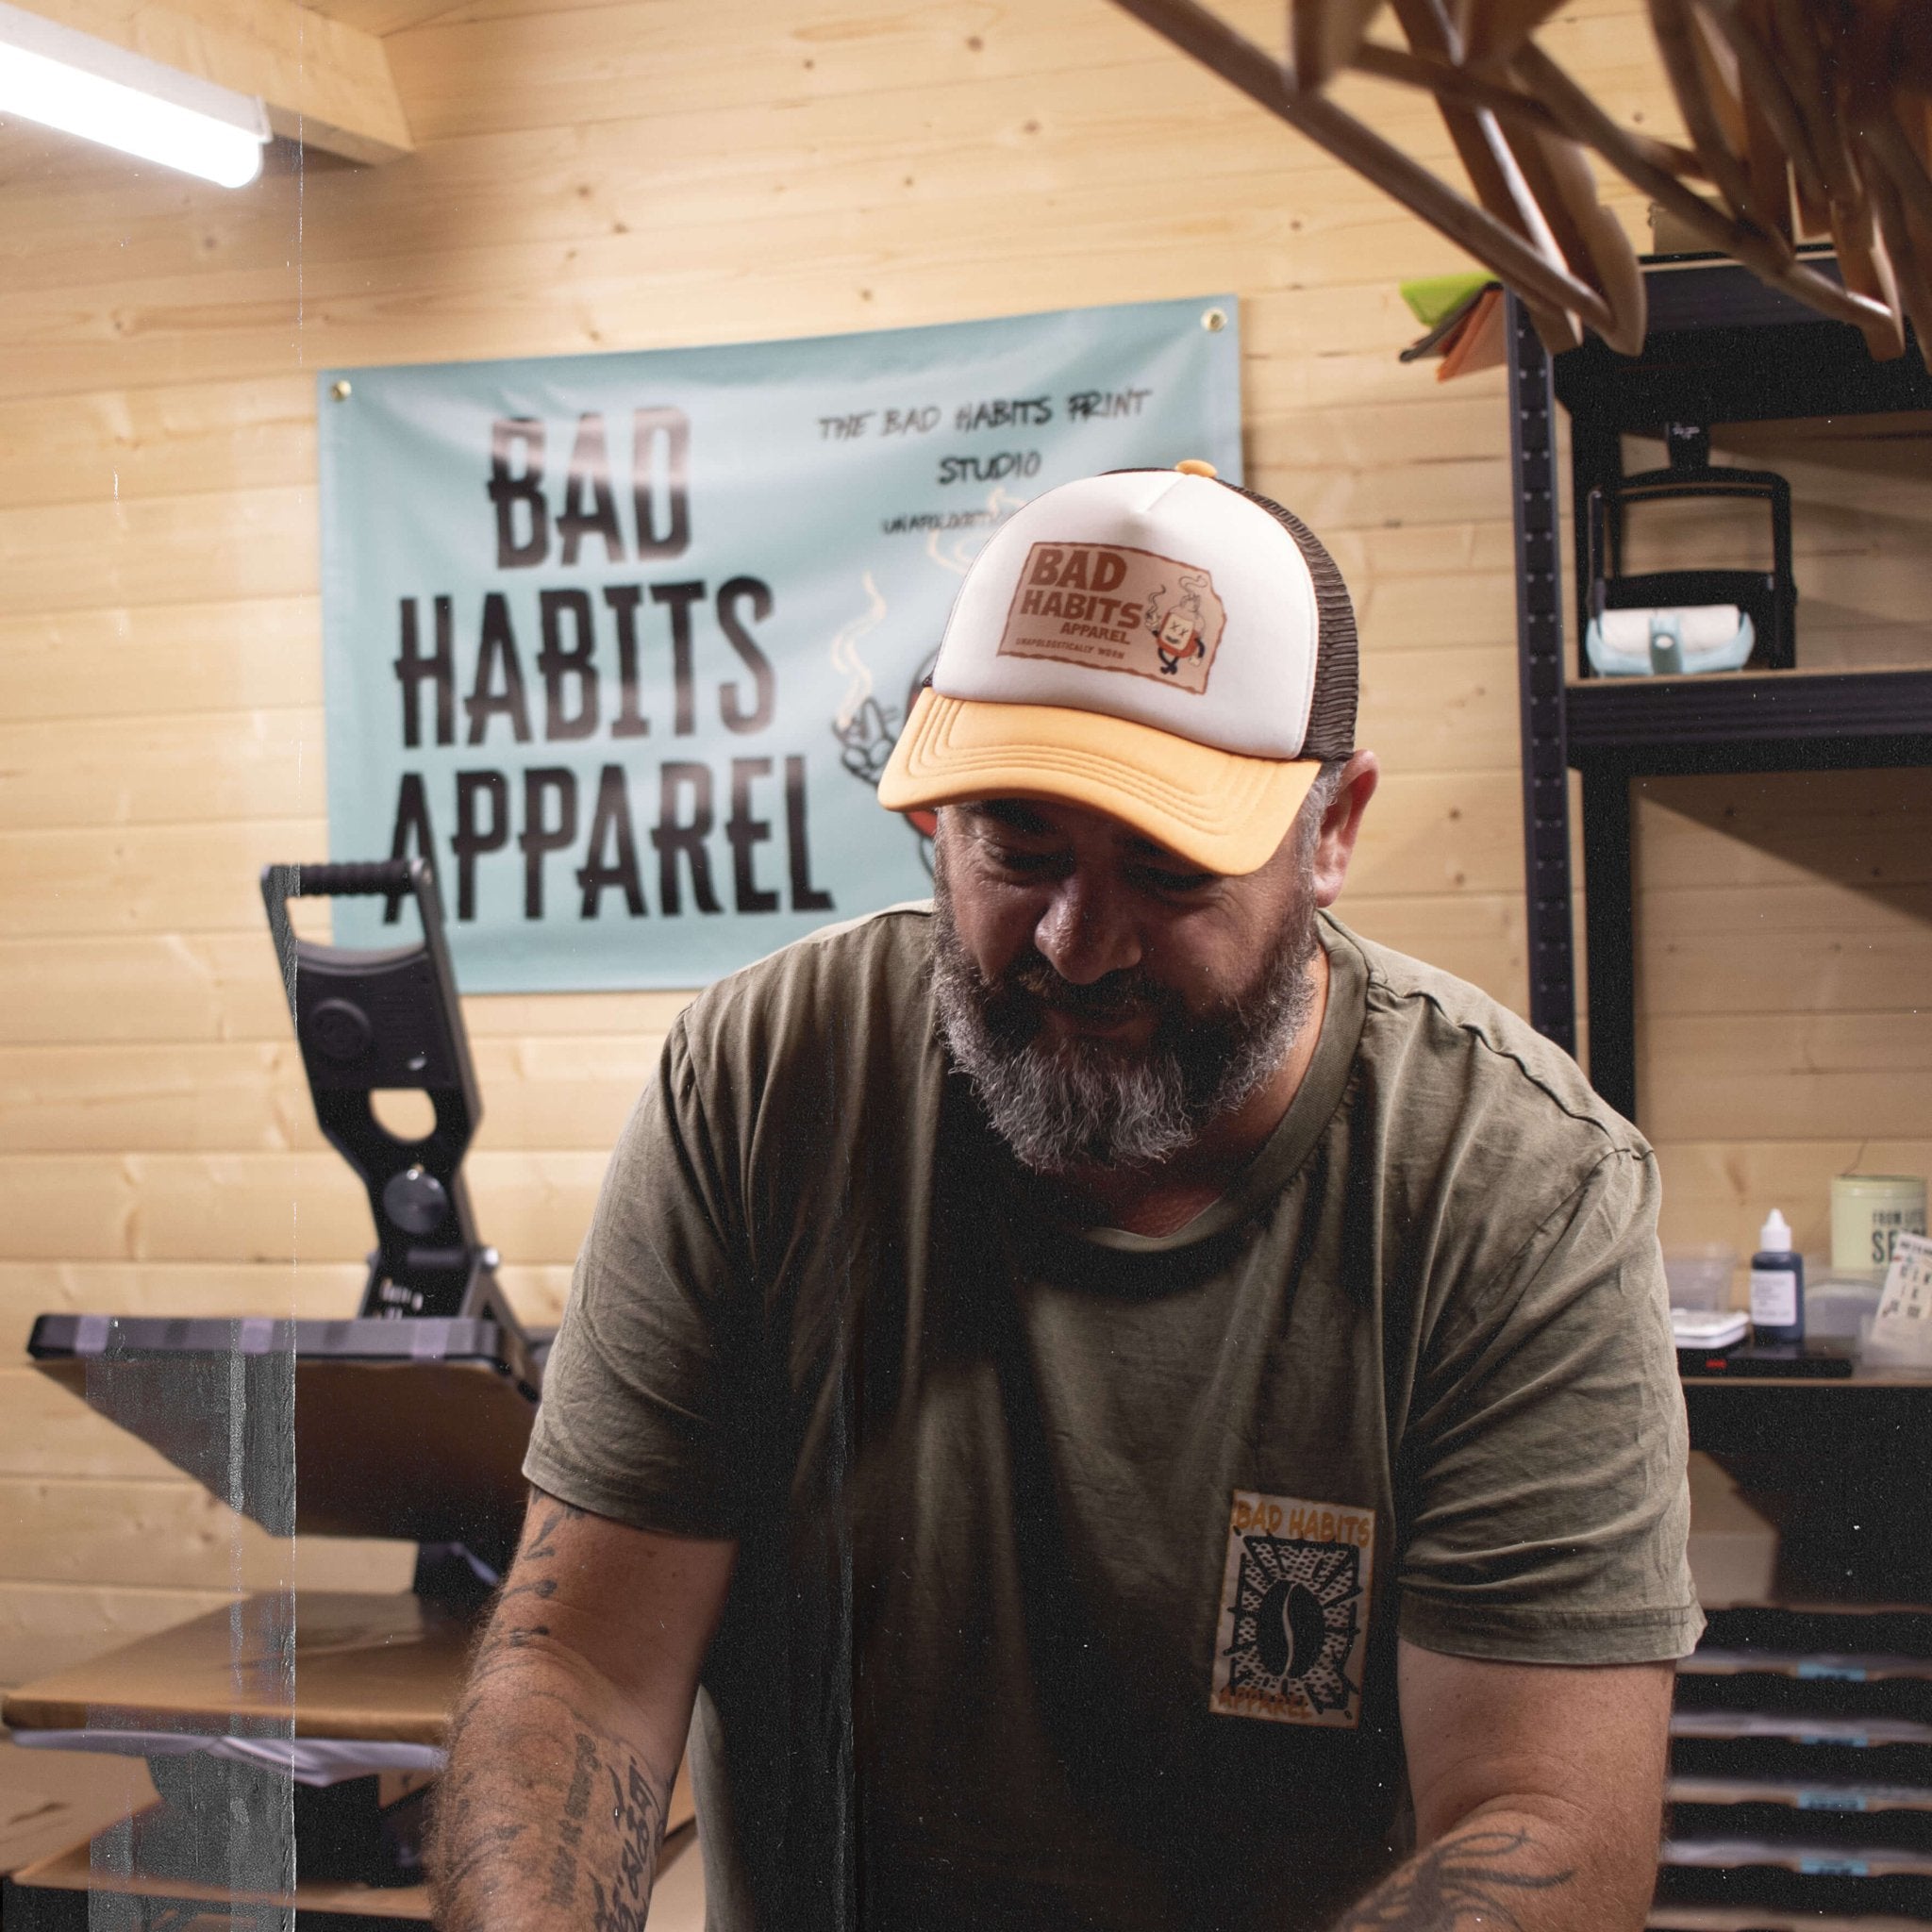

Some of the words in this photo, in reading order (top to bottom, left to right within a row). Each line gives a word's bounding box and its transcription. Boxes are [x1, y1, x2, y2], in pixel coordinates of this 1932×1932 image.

[819, 411, 875, 440] THE
[880, 406, 941, 437] BAD
[955, 394, 1054, 434] HABITS
[1066, 388, 1153, 425] PRINT
[487, 406, 691, 570] BAD
[938, 450, 1041, 486] STUDIO
[1027, 548, 1127, 592] BAD
[1019, 589, 1143, 630] HABITS
[1059, 622, 1130, 645] APPAREL
[392, 575, 775, 749] HABITS
[382, 754, 836, 925] APPAREL
[1234, 1500, 1283, 1534] BAD
[1289, 1507, 1371, 1548] HABITS
